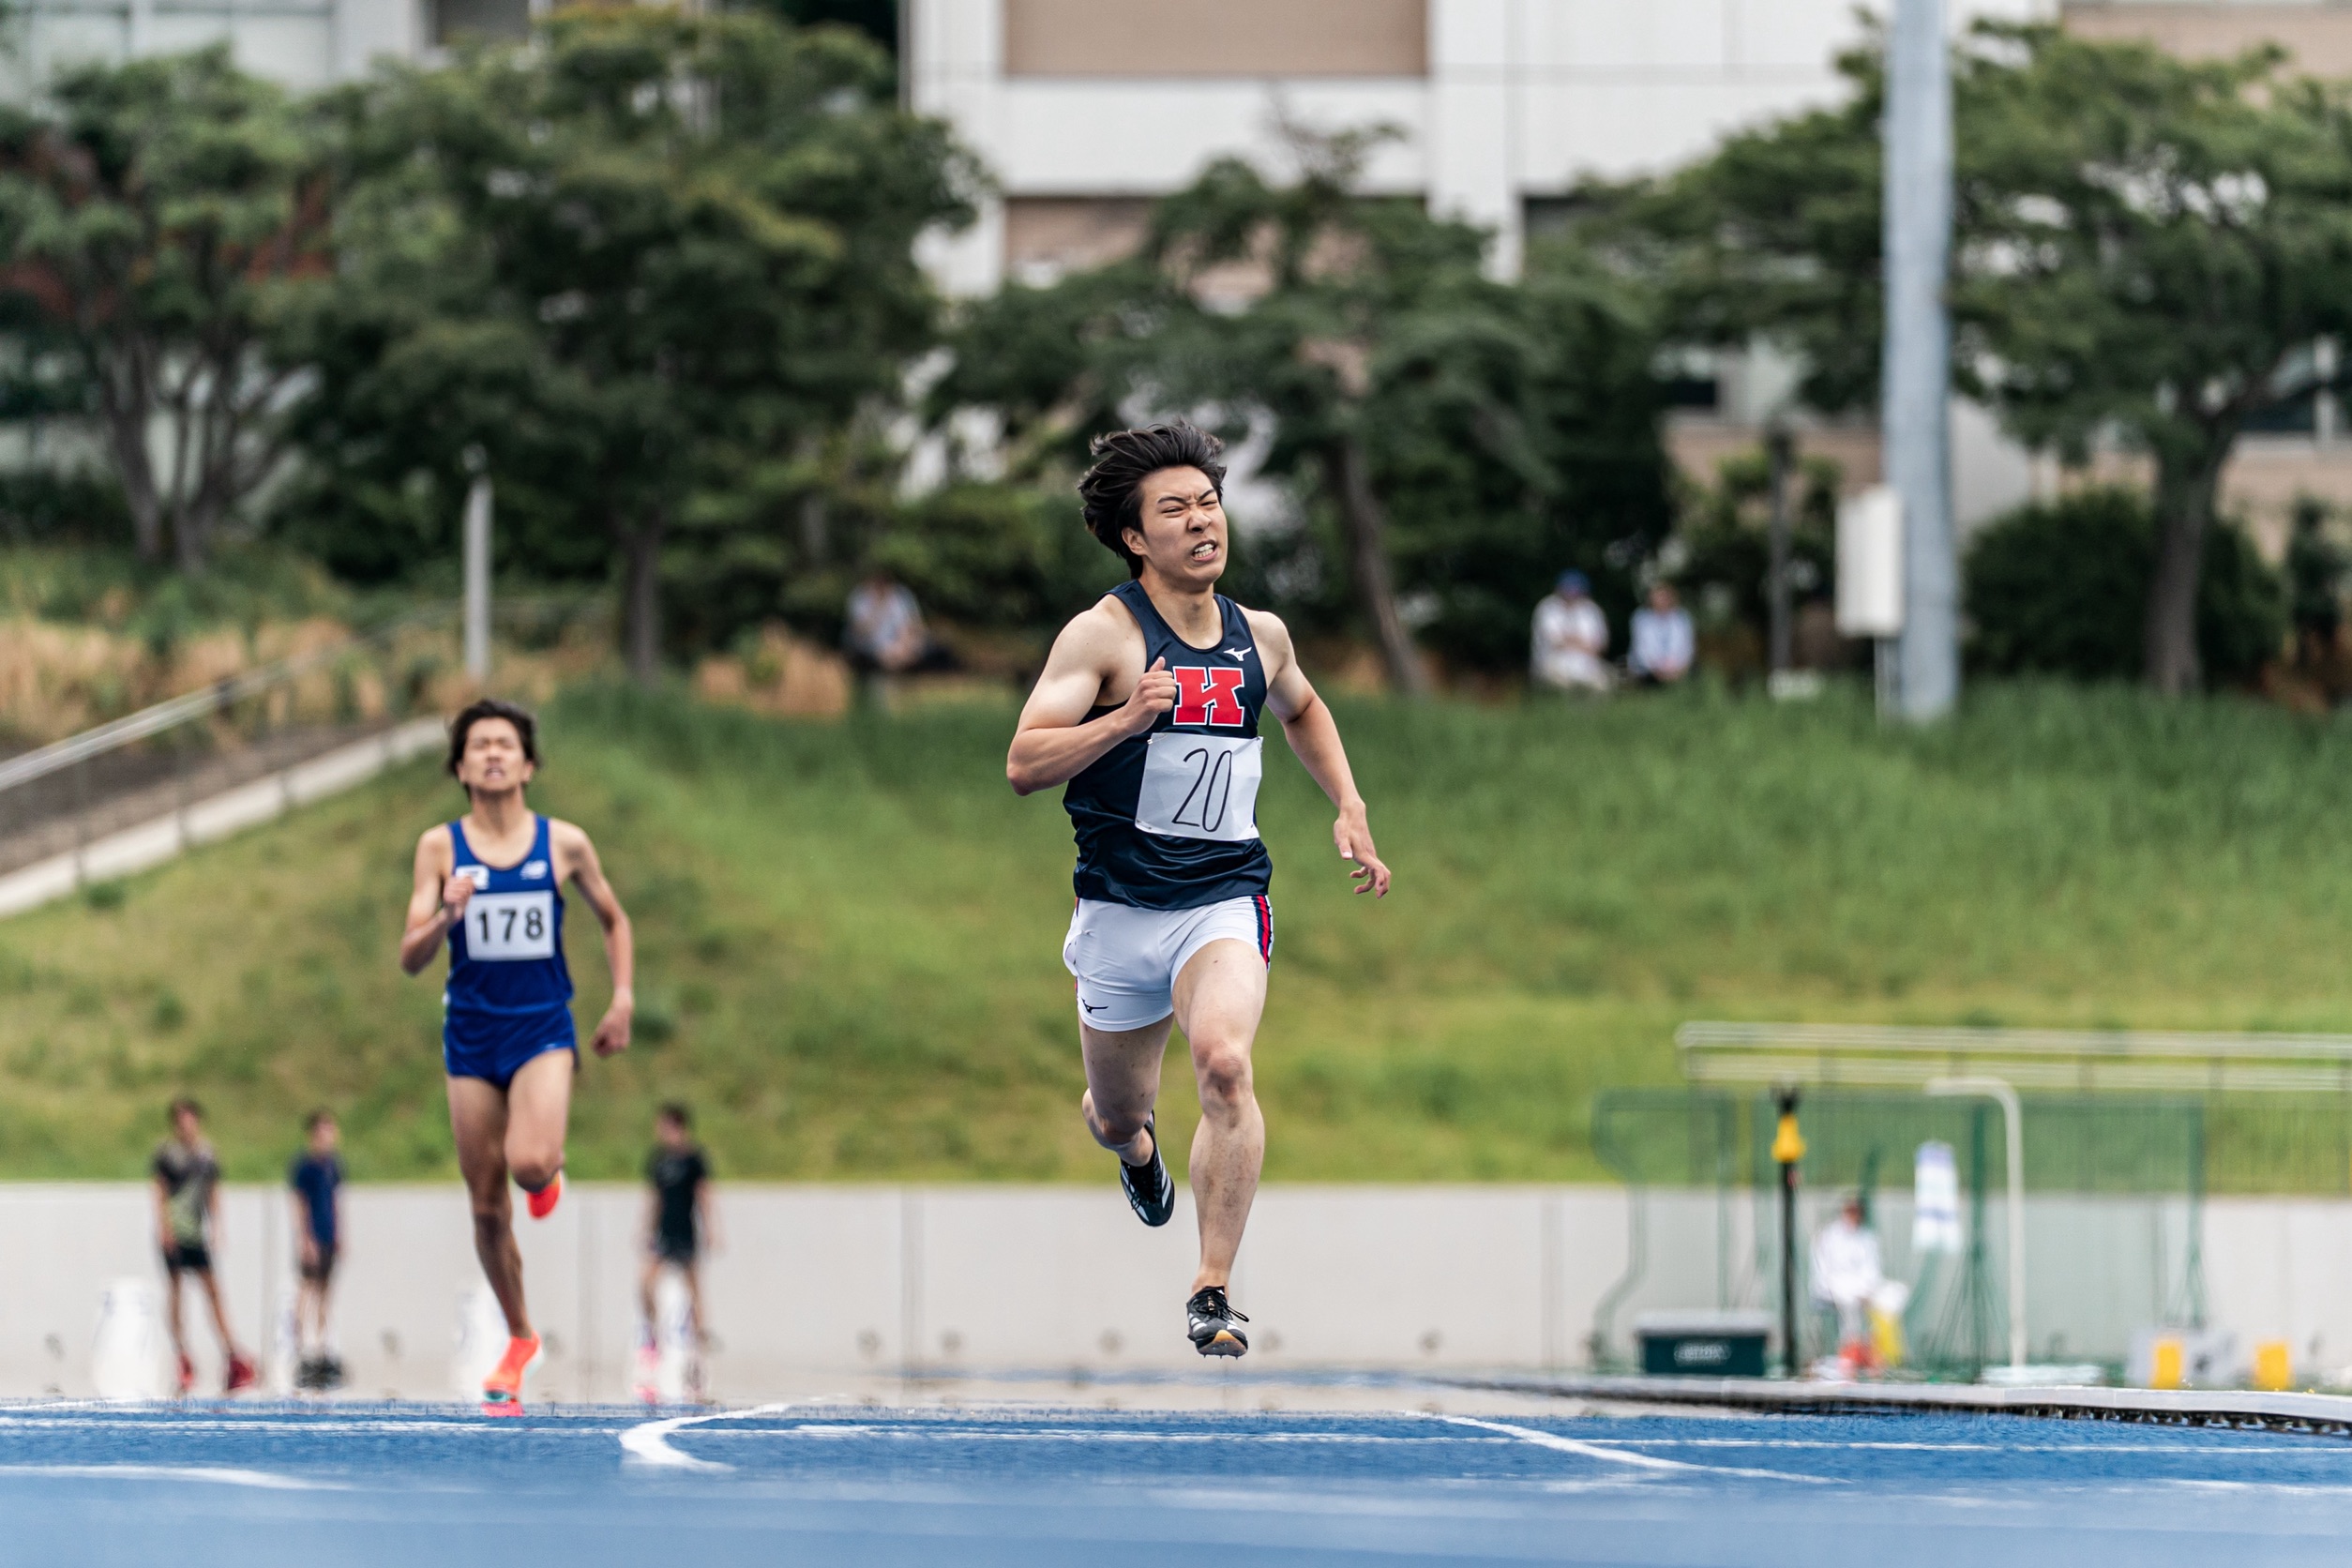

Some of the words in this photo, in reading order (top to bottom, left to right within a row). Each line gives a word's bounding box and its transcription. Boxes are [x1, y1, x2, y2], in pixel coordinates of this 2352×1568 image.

[1172, 667, 1244, 727] K
[1172, 747, 1232, 832] 20
[476, 907, 543, 942] 178
